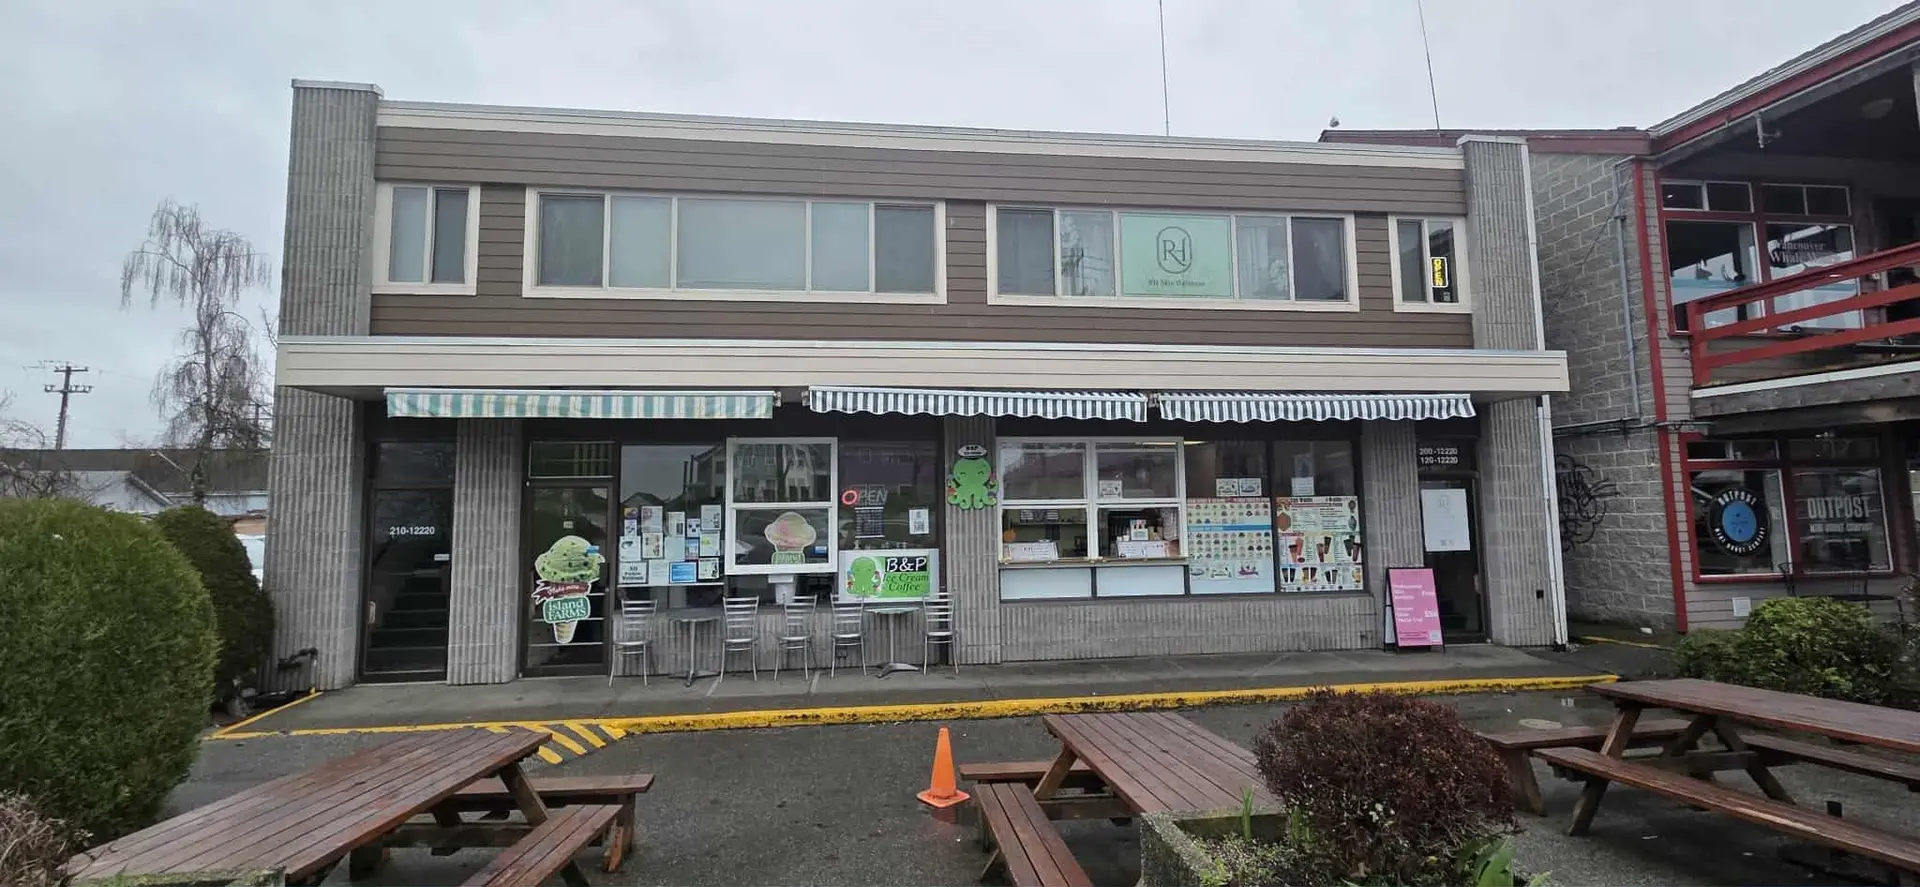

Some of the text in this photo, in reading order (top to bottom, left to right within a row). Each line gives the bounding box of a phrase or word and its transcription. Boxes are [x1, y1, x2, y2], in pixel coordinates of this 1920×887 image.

[842, 489, 888, 505] OPEN
[1717, 490, 1757, 505] OUTPOST
[1807, 496, 1871, 518] OUTPOST
[389, 526, 435, 535] 210-12220
[886, 557, 927, 572] B&P
[883, 573, 929, 583] Ice Cream
[889, 583, 921, 593] Coffee
[548, 607, 586, 620] FARMS
